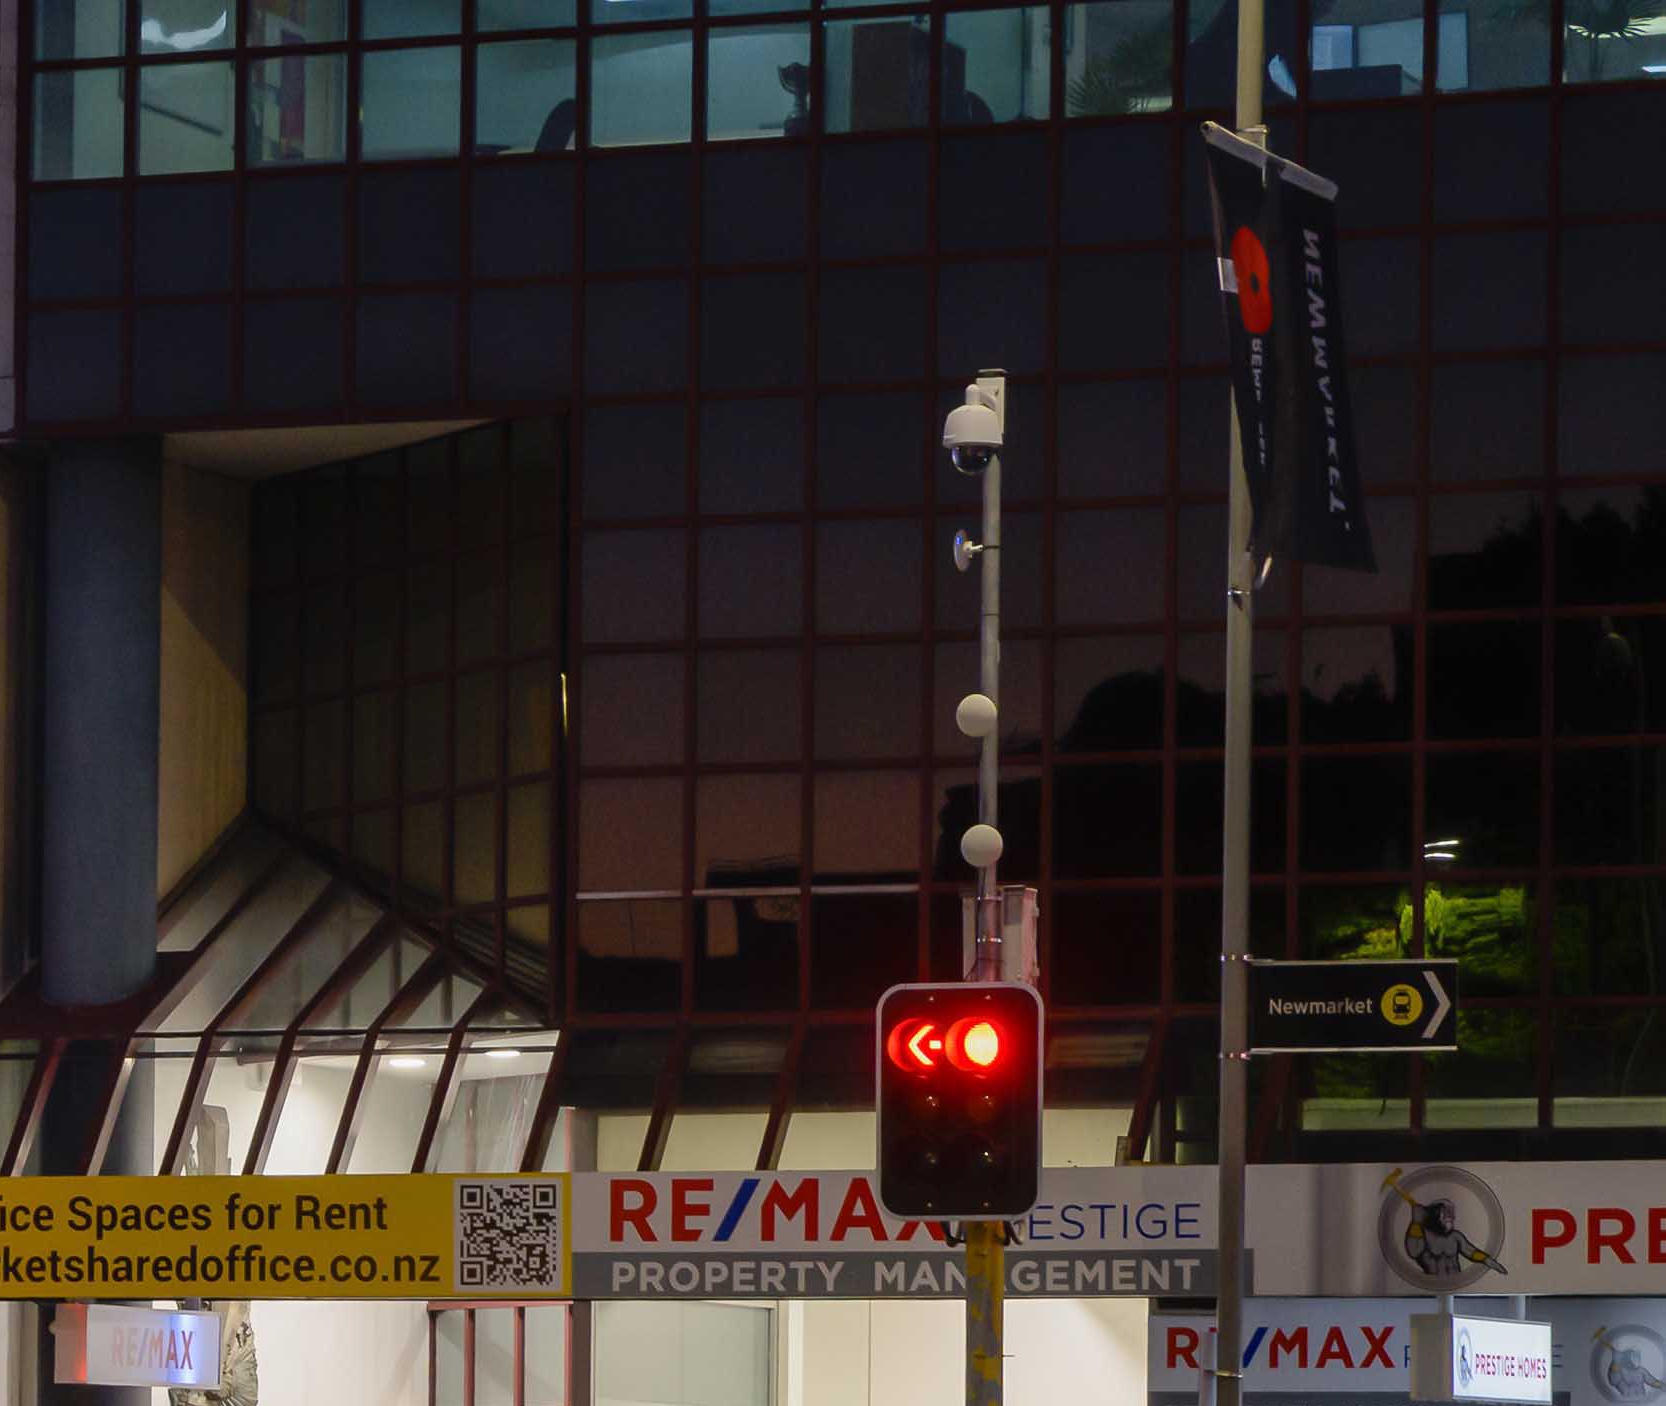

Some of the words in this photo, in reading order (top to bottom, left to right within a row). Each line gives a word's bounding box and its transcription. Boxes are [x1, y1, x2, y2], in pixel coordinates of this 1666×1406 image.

[1268, 998, 1373, 1015] Newmarket
[67, 1196, 212, 1244] Spaces
[225, 1194, 283, 1232] for
[295, 1195, 388, 1232] Rent
[1016, 1203, 1202, 1240] ESTIGE
[611, 1258, 845, 1294] PROPERTY
[874, 1257, 1202, 1293] MANGEMENT
[111, 1330, 195, 1371] RE/MAX
[1168, 1325, 1395, 1369] R/MAX
[1475, 1353, 1515, 1377] PRESTIGE
[1517, 1357, 1547, 1380] HOMES
